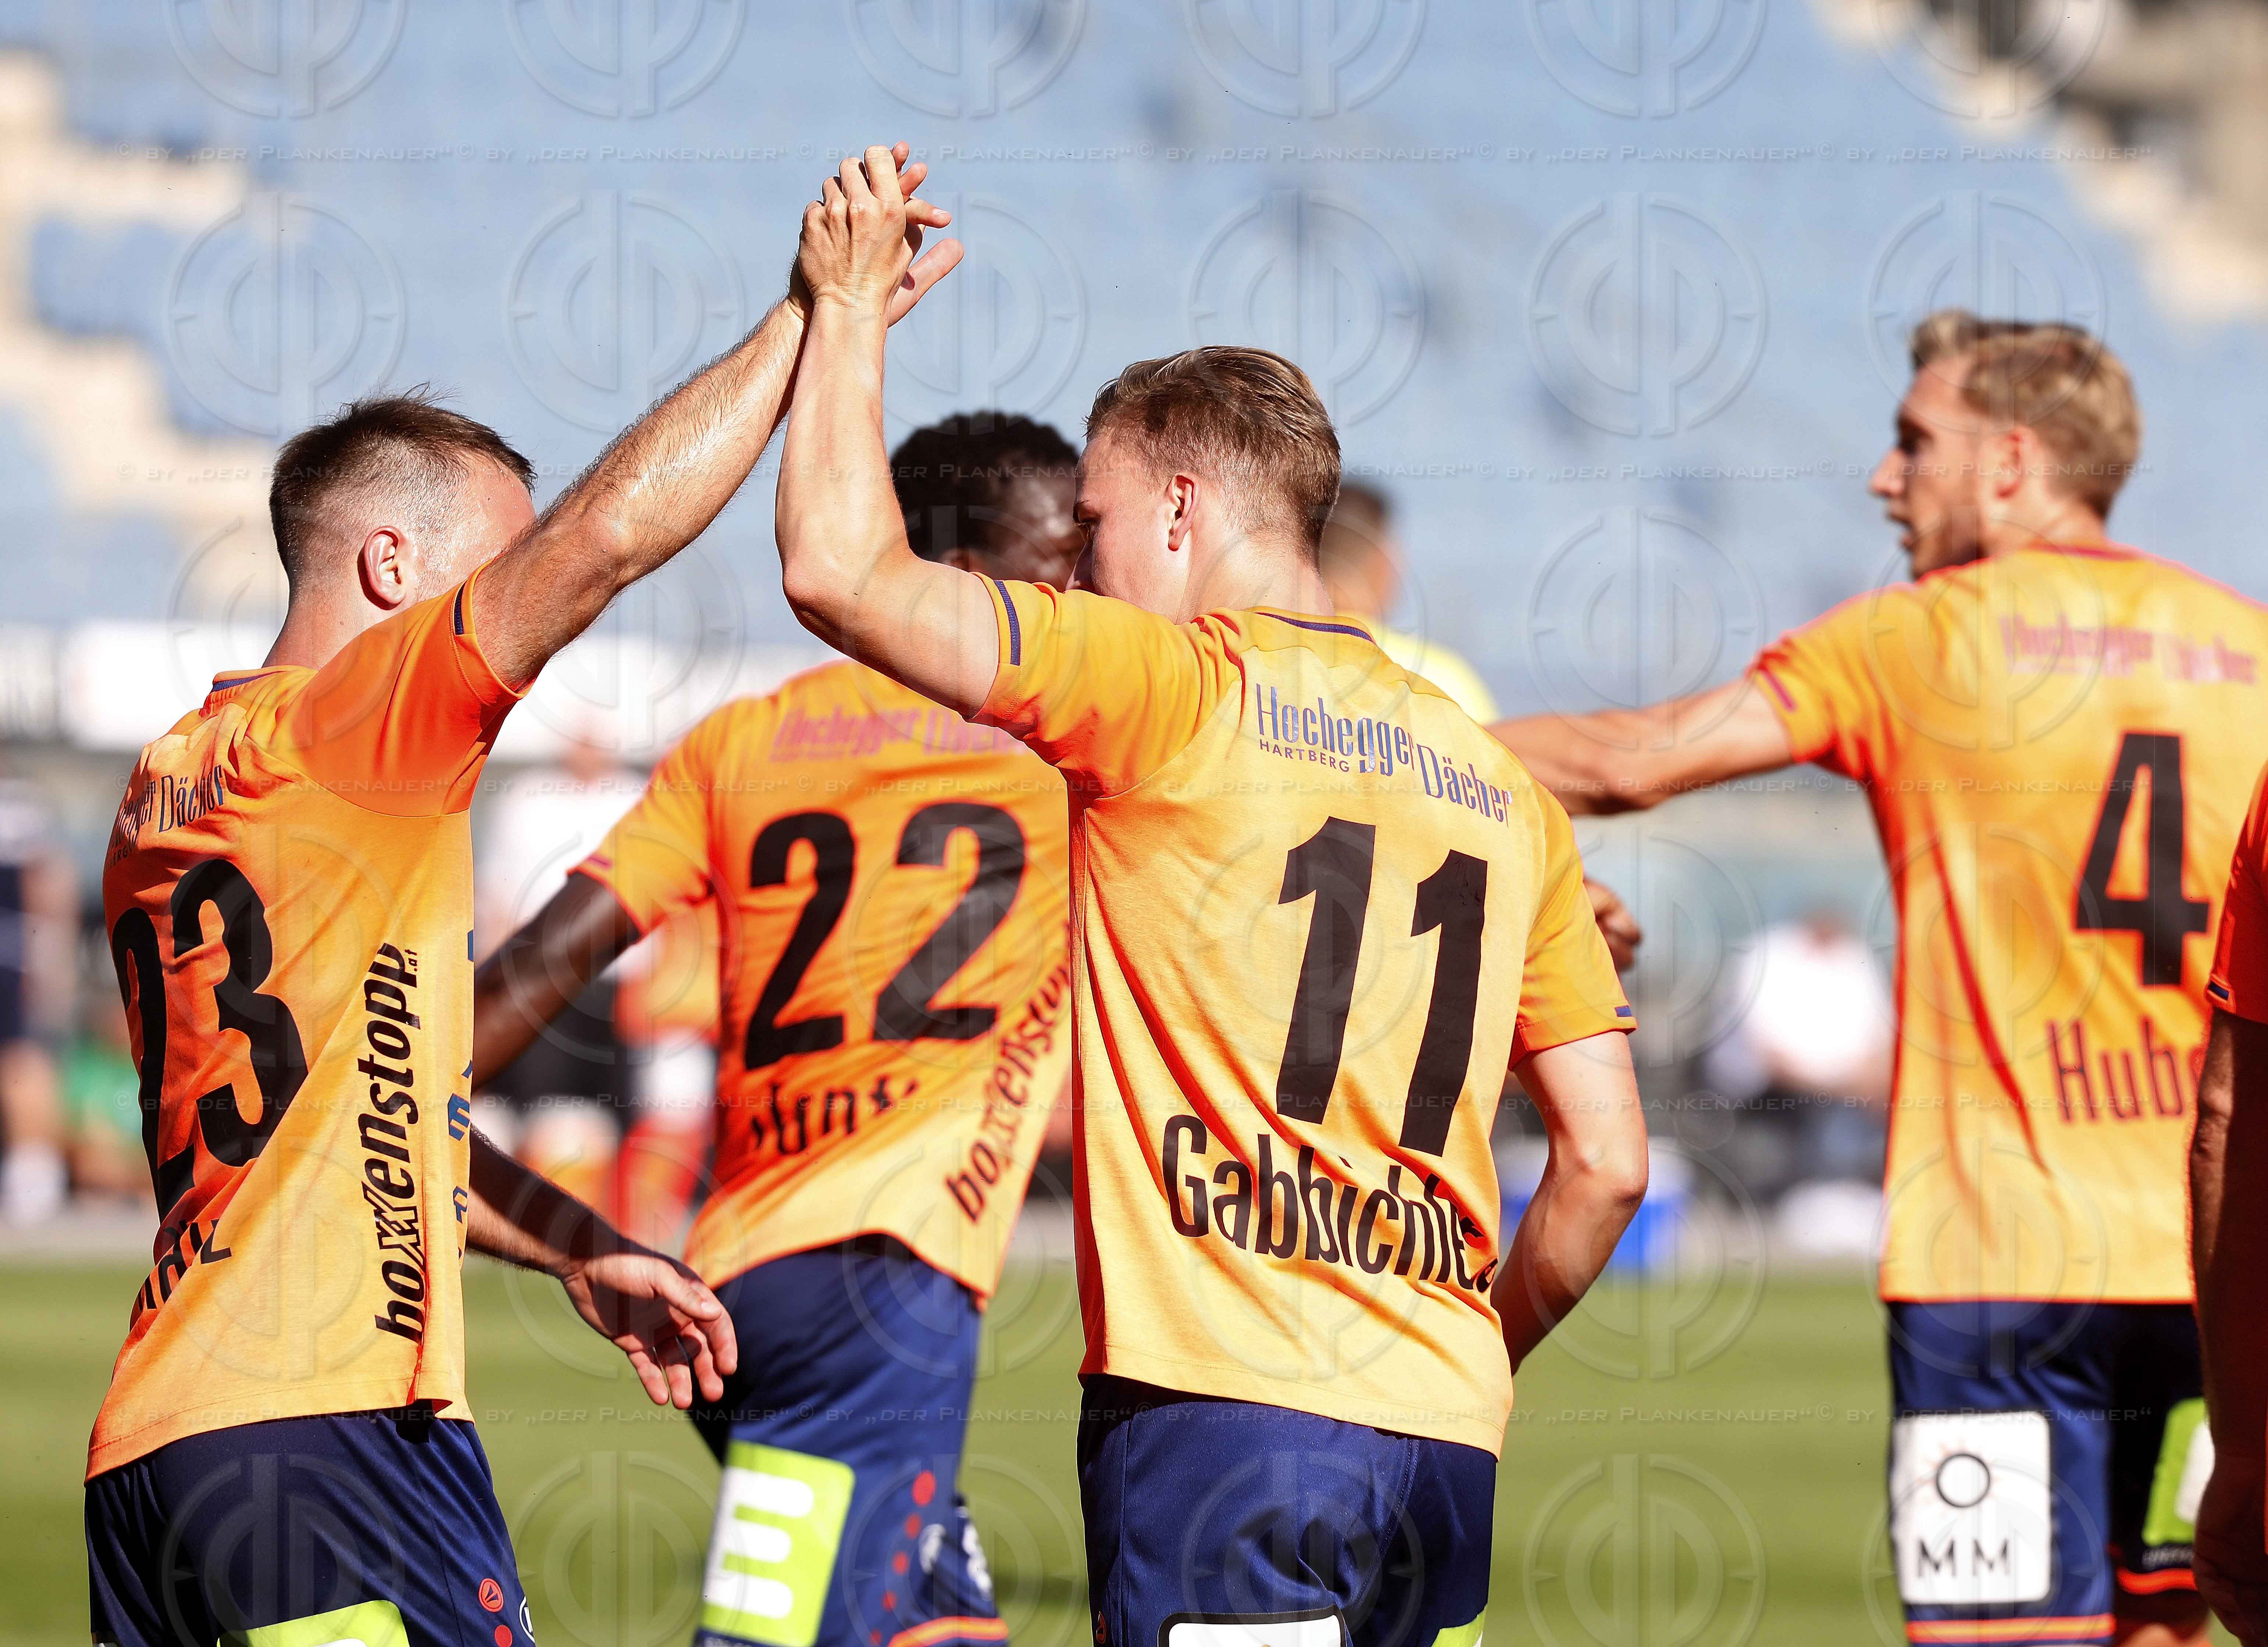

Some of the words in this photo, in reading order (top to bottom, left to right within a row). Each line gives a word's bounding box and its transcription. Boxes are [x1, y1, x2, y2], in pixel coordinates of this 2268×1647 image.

[1256, 683, 1414, 777] Hochegger
[1416, 743, 1512, 828] Dächer
[1259, 739, 1350, 772] HARTBERG
[2076, 732, 2211, 986] 4
[113, 858, 309, 1221] 23
[745, 803, 1026, 1071] 22
[1276, 815, 1488, 1157] 11
